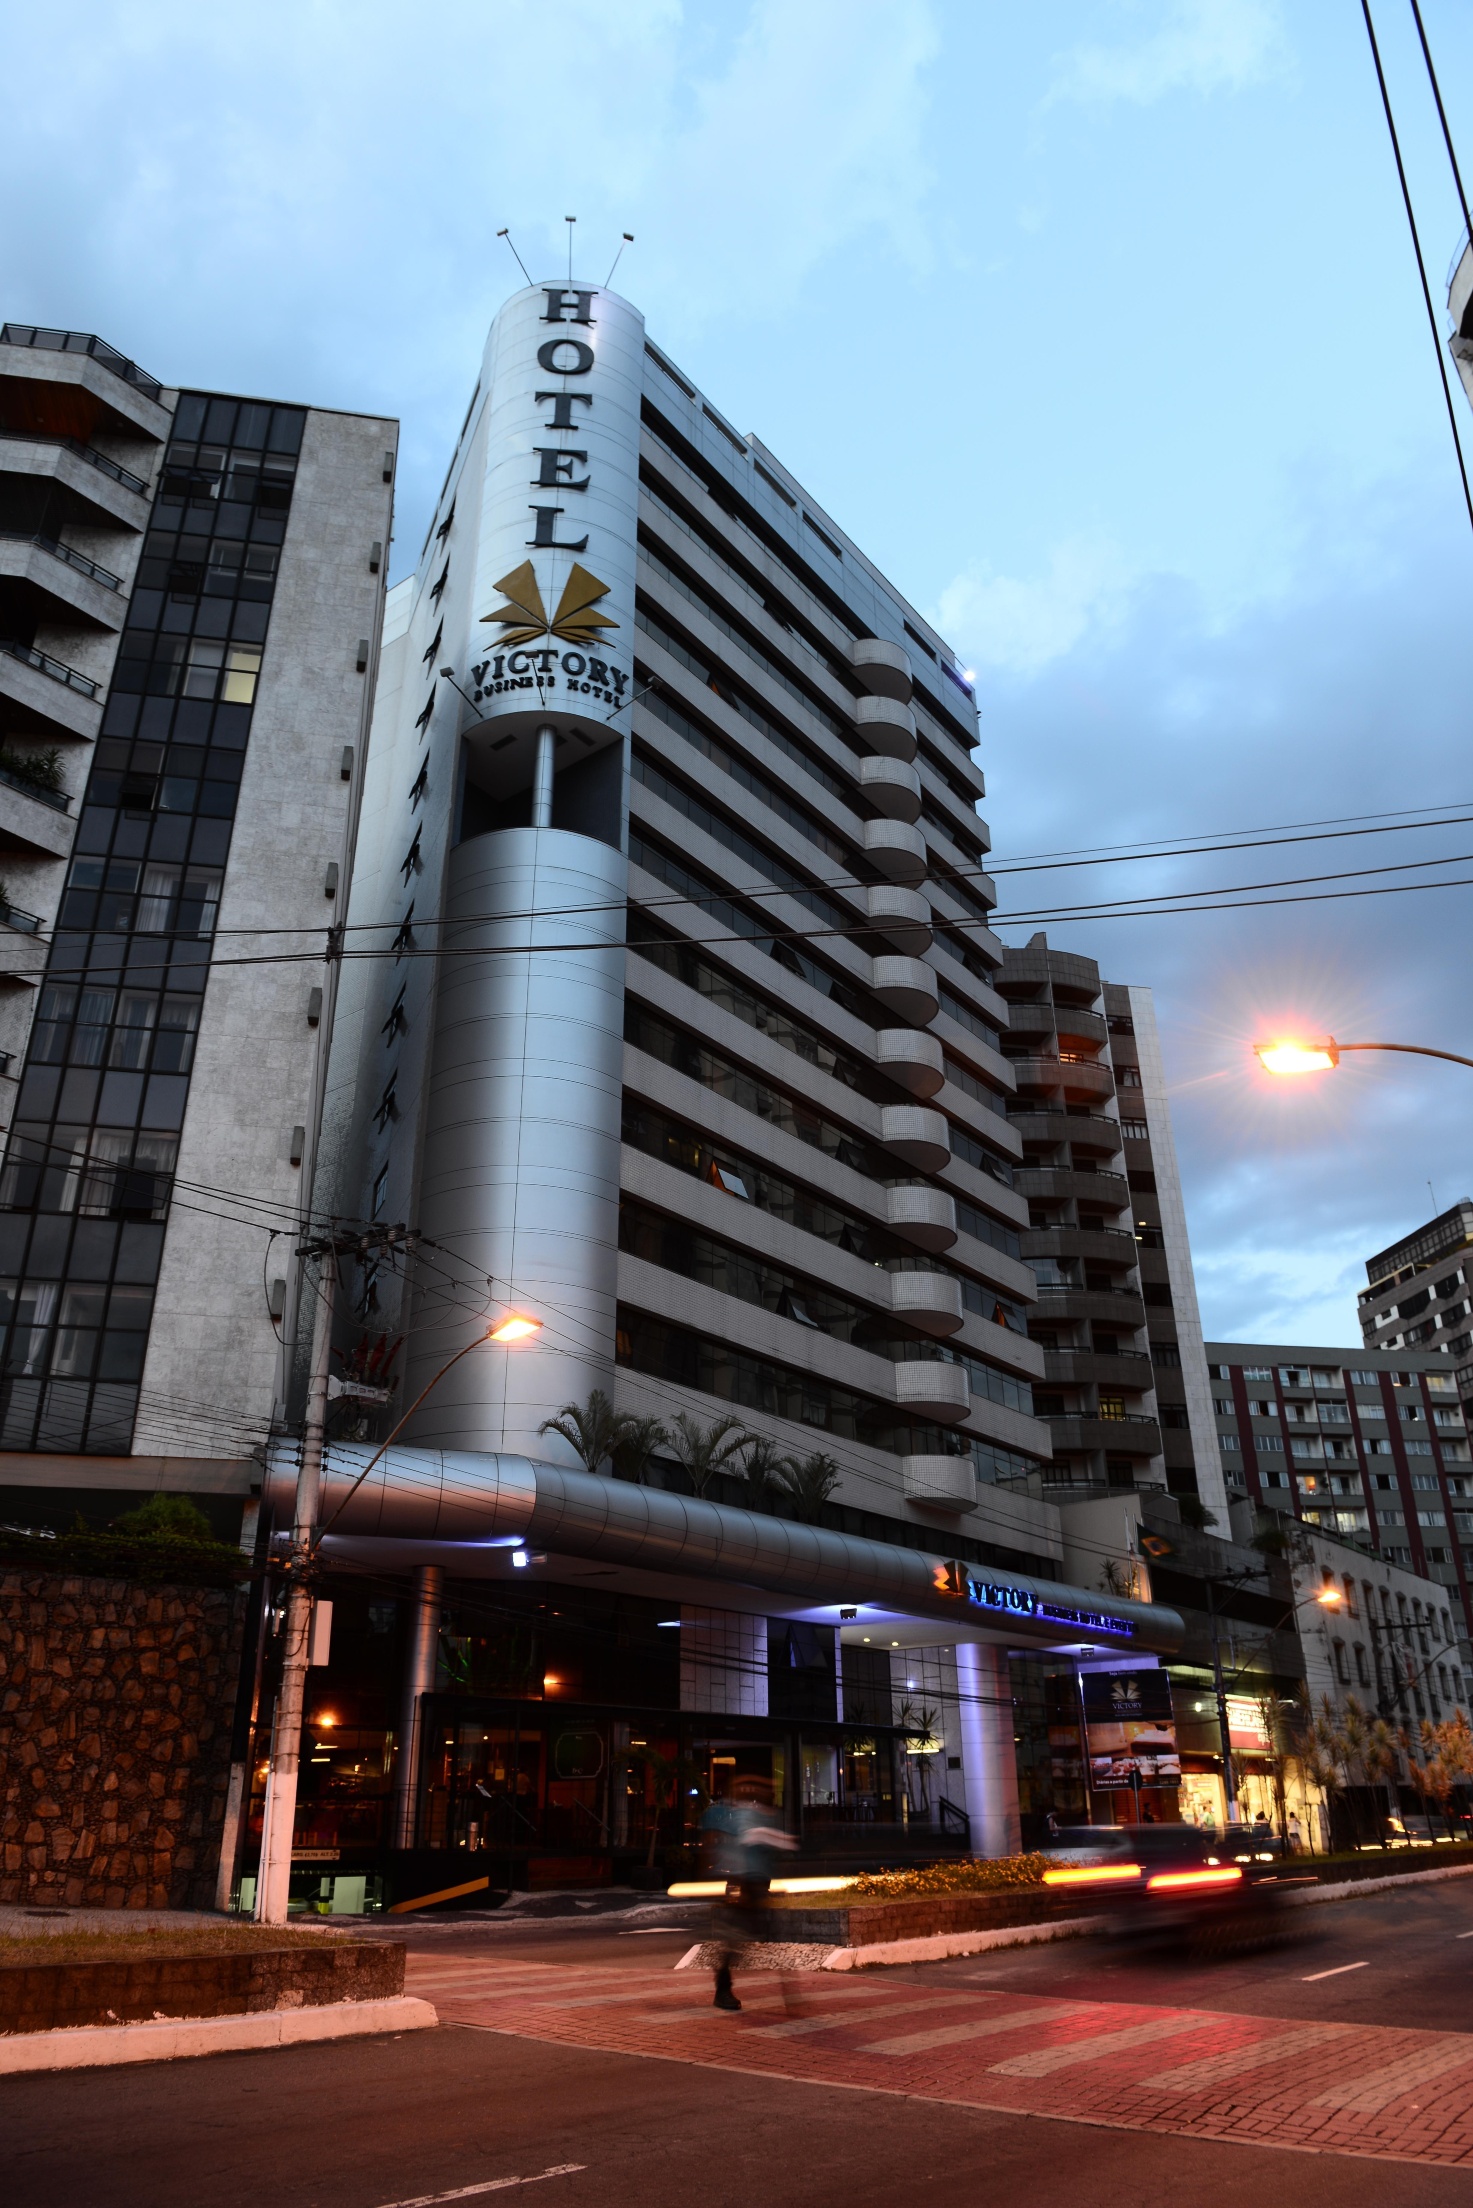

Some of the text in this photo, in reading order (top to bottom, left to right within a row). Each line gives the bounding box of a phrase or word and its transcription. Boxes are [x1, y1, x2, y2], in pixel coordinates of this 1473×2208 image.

[525, 288, 598, 551] HOTEL
[471, 650, 629, 695] VICTORY
[473, 675, 622, 708] BUSINESS HOTEL
[973, 1580, 1039, 1614] VICTORY
[1079, 1612, 1102, 1626] HOTEL
